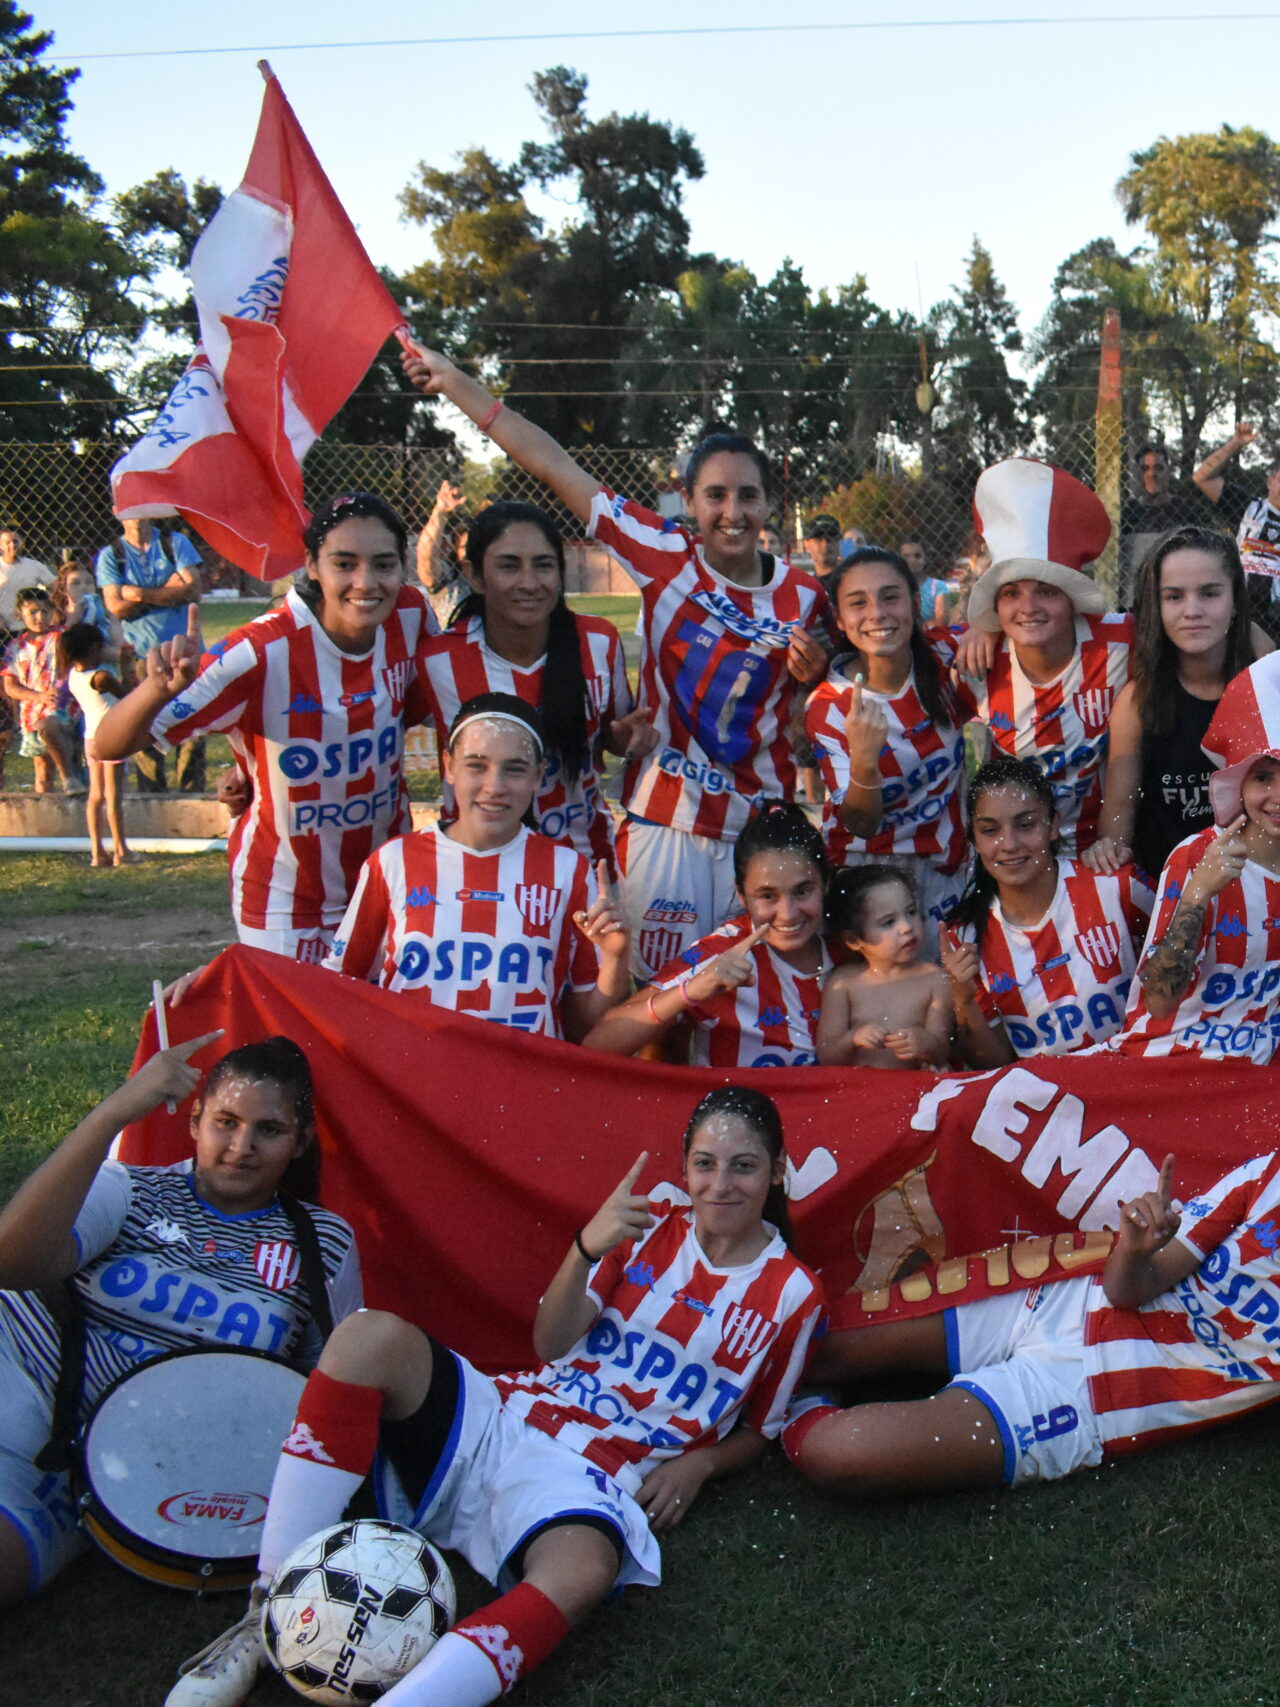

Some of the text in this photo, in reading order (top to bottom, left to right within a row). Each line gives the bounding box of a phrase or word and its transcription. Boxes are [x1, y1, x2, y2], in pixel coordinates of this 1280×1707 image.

[278, 724, 400, 781] OSPA
[99, 1256, 293, 1355] OSPAT
[585, 1317, 744, 1425] OSPAT
[183, 1502, 245, 1521] FAMA
